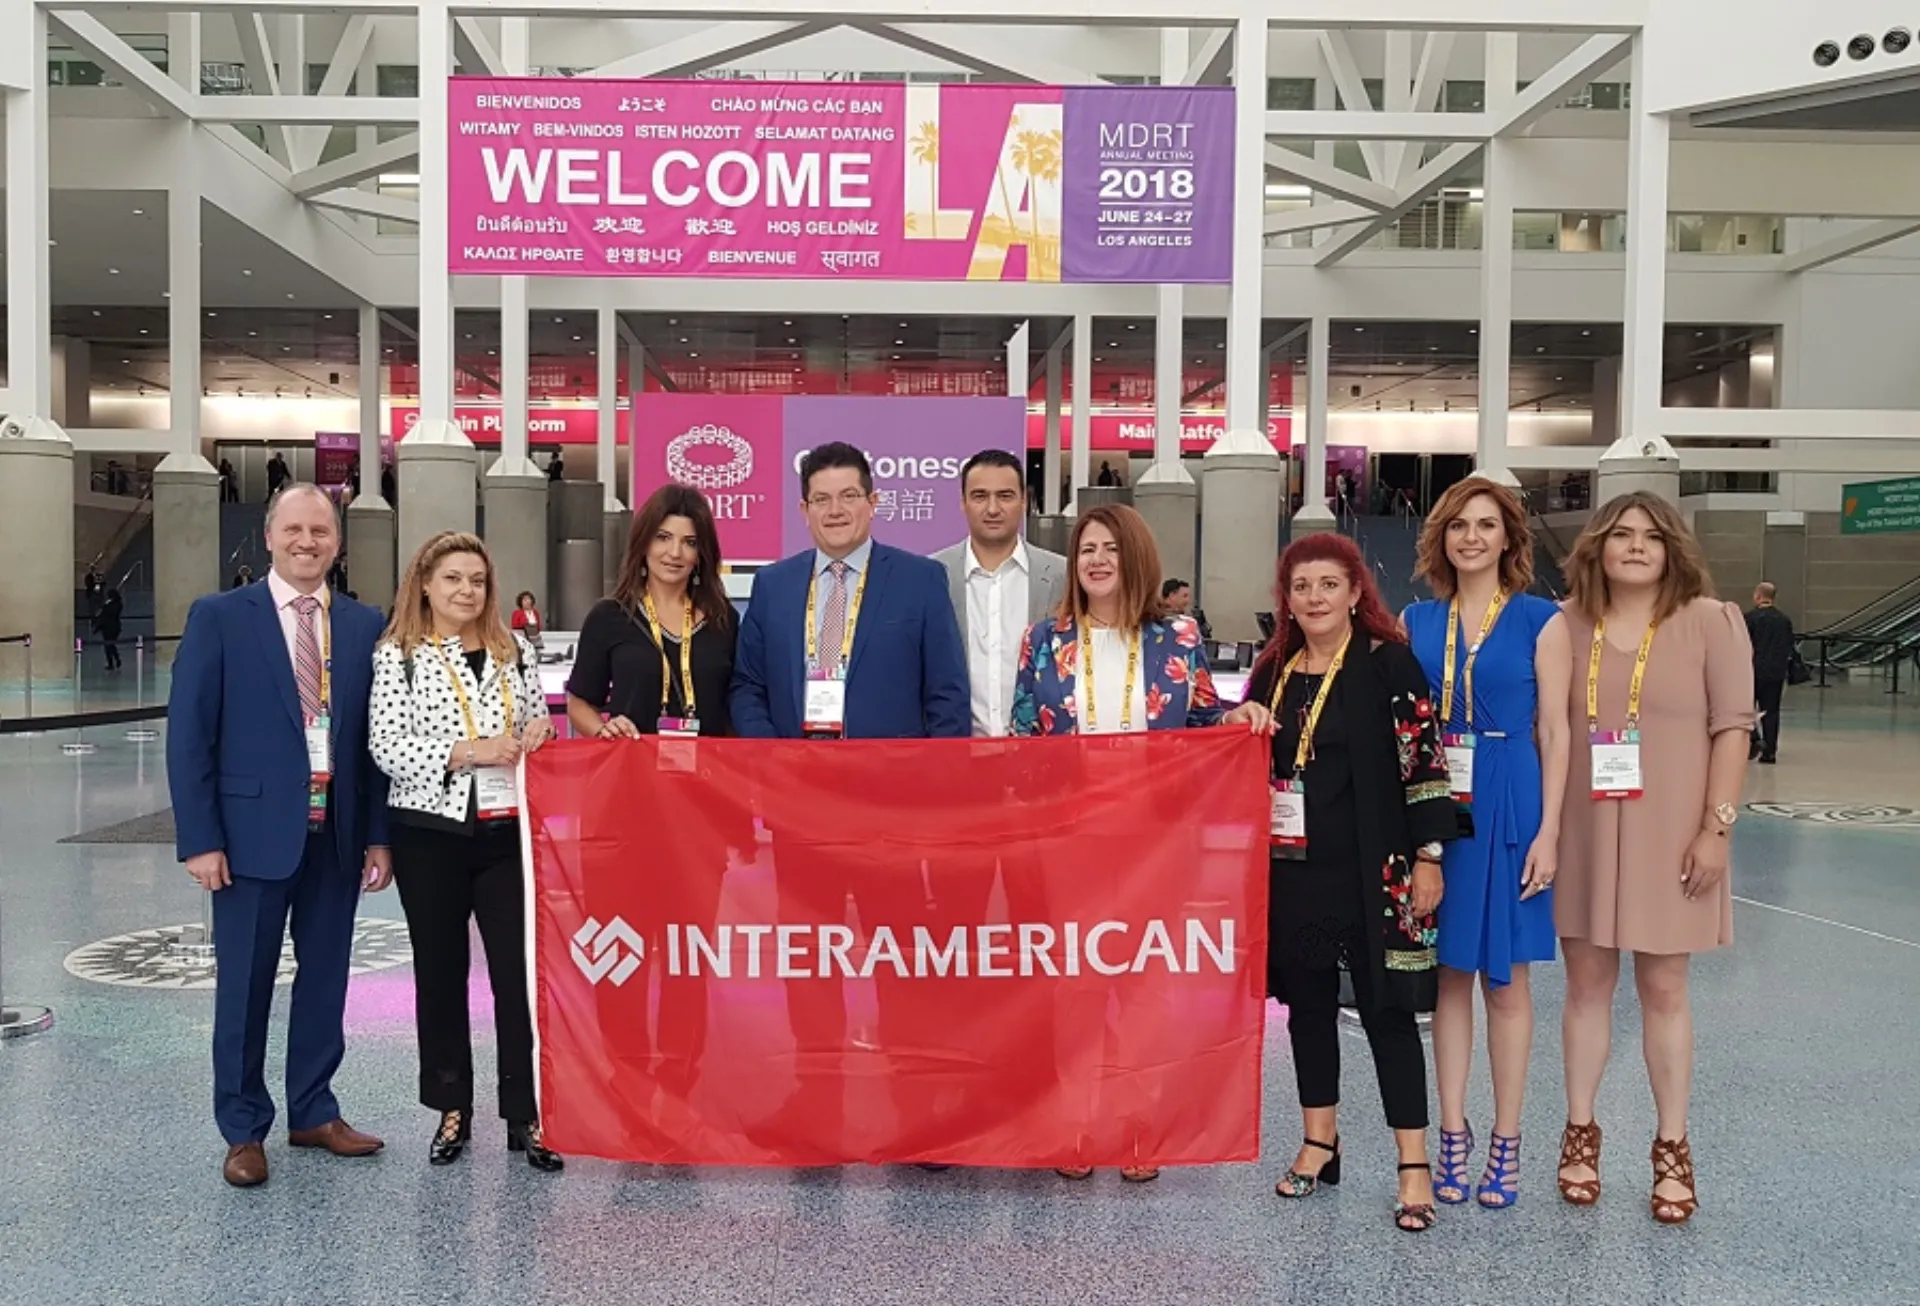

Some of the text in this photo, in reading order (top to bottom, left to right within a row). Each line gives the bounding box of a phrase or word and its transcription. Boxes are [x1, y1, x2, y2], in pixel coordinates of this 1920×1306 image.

[477, 95, 582, 110] BIENVENIDOS
[618, 97, 667, 112] ようこそ
[459, 122, 521, 136] WITAMY
[533, 122, 624, 137] BEM-VINDOS
[635, 124, 742, 139] ISTEN HOZOTT
[754, 126, 895, 141] SELAMAT DATANG
[1099, 122, 1195, 148] MDRT
[1100, 150, 1194, 160] ANNUAL MEETING
[481, 147, 873, 208] WELCOME
[1098, 168, 1195, 199] 2018
[1098, 210, 1140, 223] JUNE
[592, 216, 646, 234] 欢迎
[684, 217, 737, 236] 歡迎
[767, 220, 800, 237] HOŞ
[1098, 235, 1192, 246] LOS ANGELES
[605, 247, 683, 263] 환영합니다
[708, 250, 796, 264] BIENVENUE
[666, 918, 1237, 978] INTERAMERICAN
